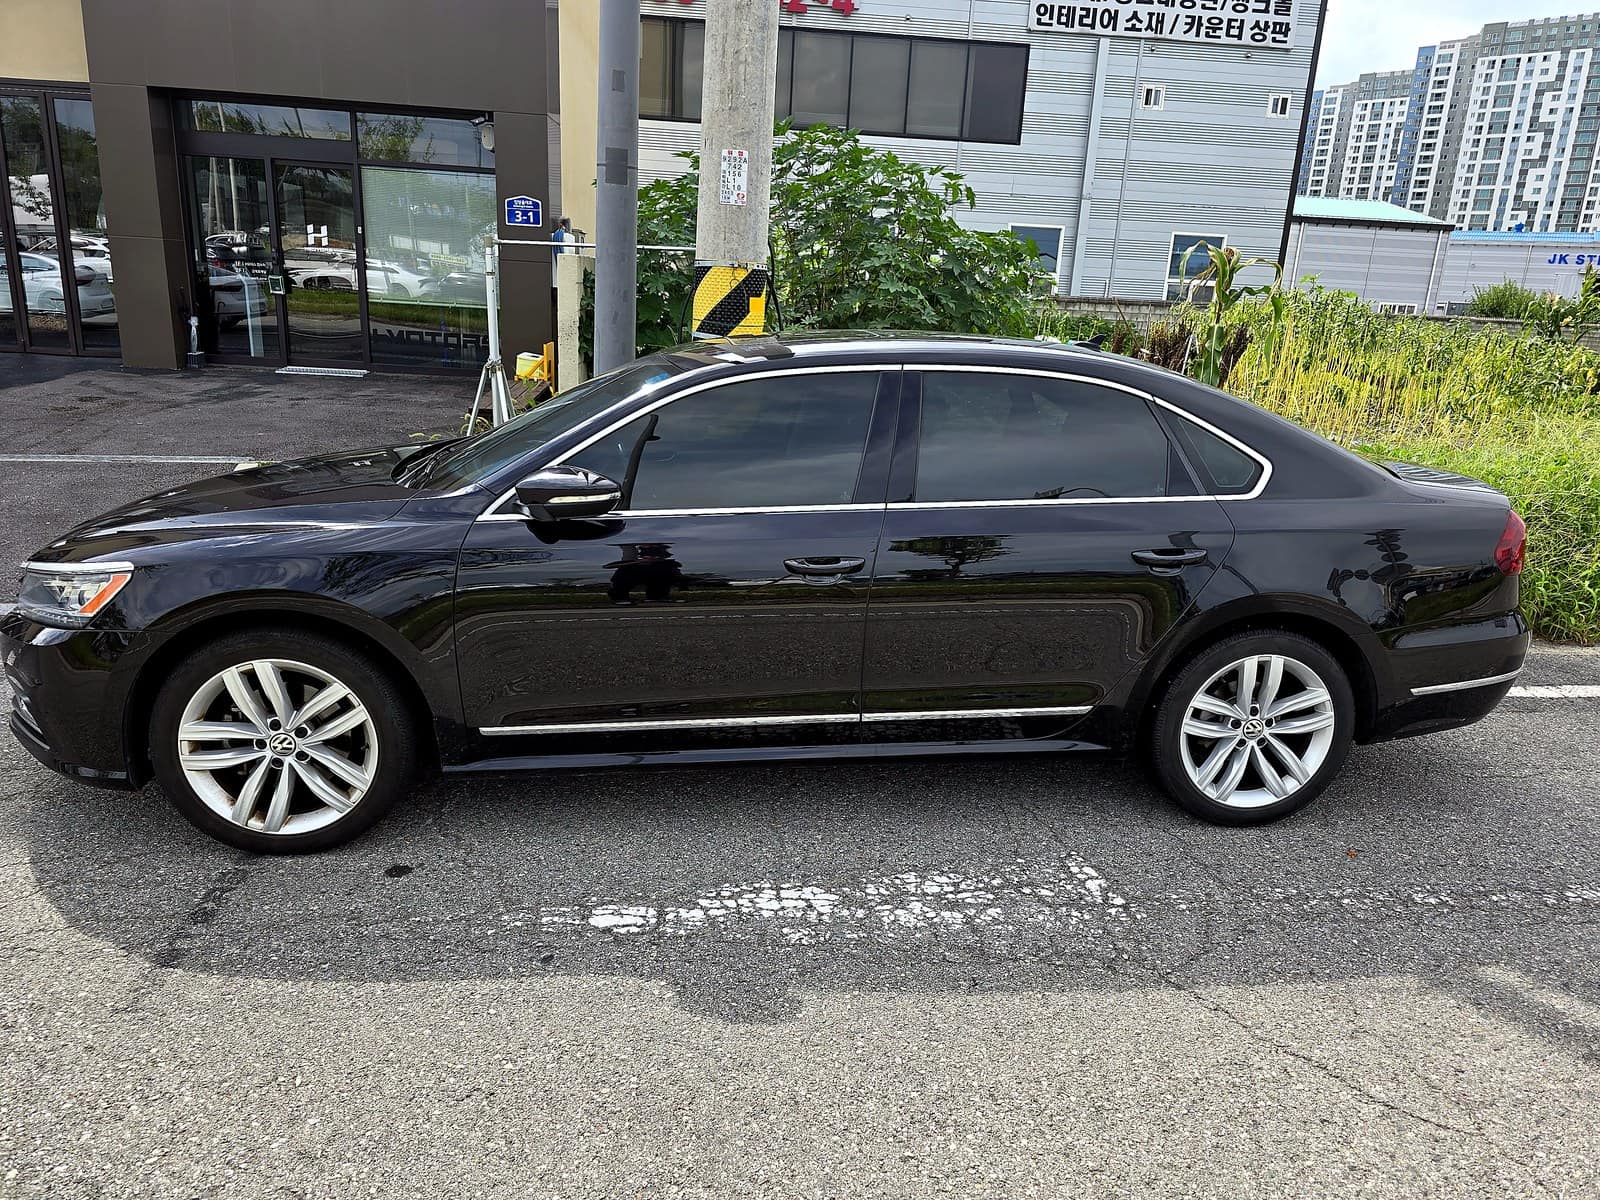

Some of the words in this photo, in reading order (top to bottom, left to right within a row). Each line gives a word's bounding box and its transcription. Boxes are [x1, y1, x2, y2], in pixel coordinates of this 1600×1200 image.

[1036, 3, 1120, 32] 인테리어
[1124, 10, 1166, 35] 소재
[1183, 15, 1246, 41] 카운터
[1249, 20, 1292, 44] 상판
[514, 210, 535, 224] 3-1
[1547, 253, 1570, 265] JK
[1575, 254, 1600, 266] ST
